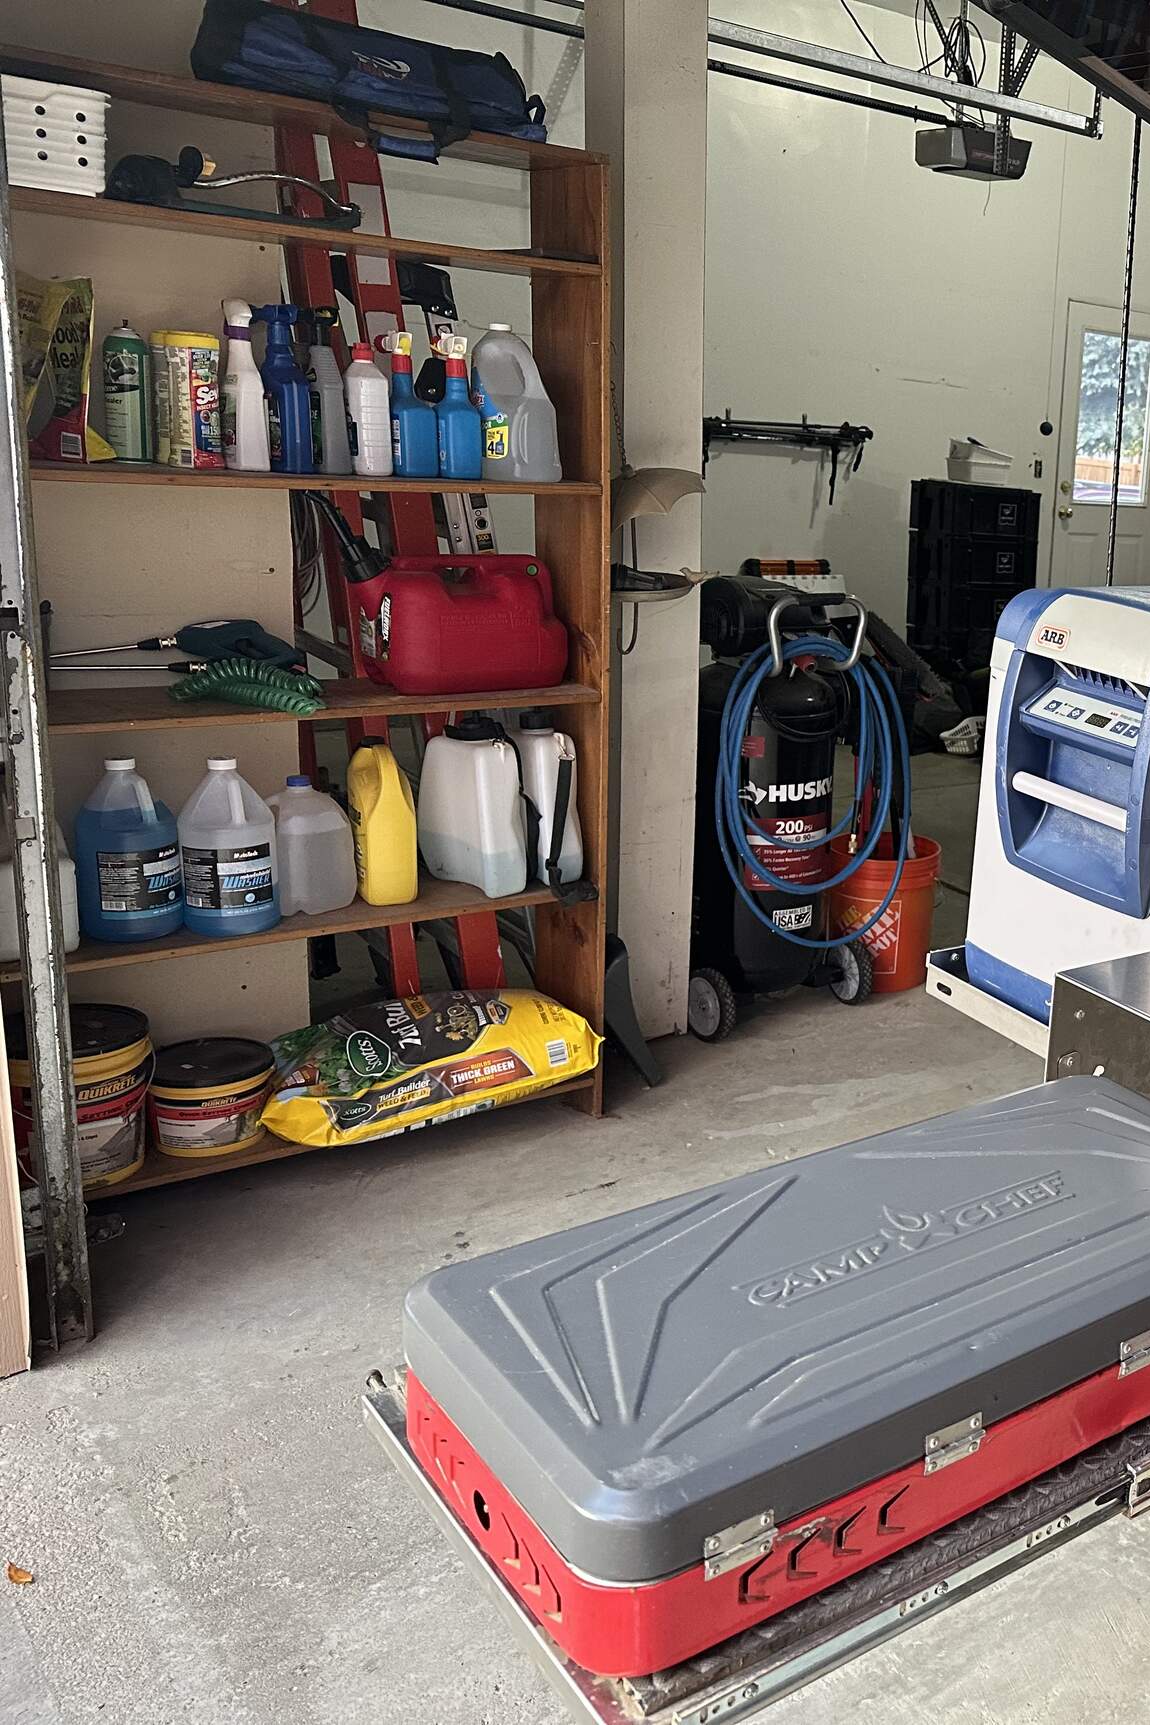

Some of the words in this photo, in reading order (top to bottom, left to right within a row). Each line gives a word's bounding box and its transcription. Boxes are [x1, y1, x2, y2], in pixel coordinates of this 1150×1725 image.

[1041, 629, 1065, 645] ARB
[768, 775, 833, 803] HUSKY
[775, 820, 804, 835] 200
[450, 1067, 483, 1084] THICK
[483, 1059, 515, 1075] GREEN
[78, 1075, 137, 1100] QUIKRETE
[379, 1091, 396, 1102] Turf
[396, 1080, 430, 1095] Builder
[748, 1243, 890, 1307] CAMP
[955, 1175, 1065, 1228] CHEF
